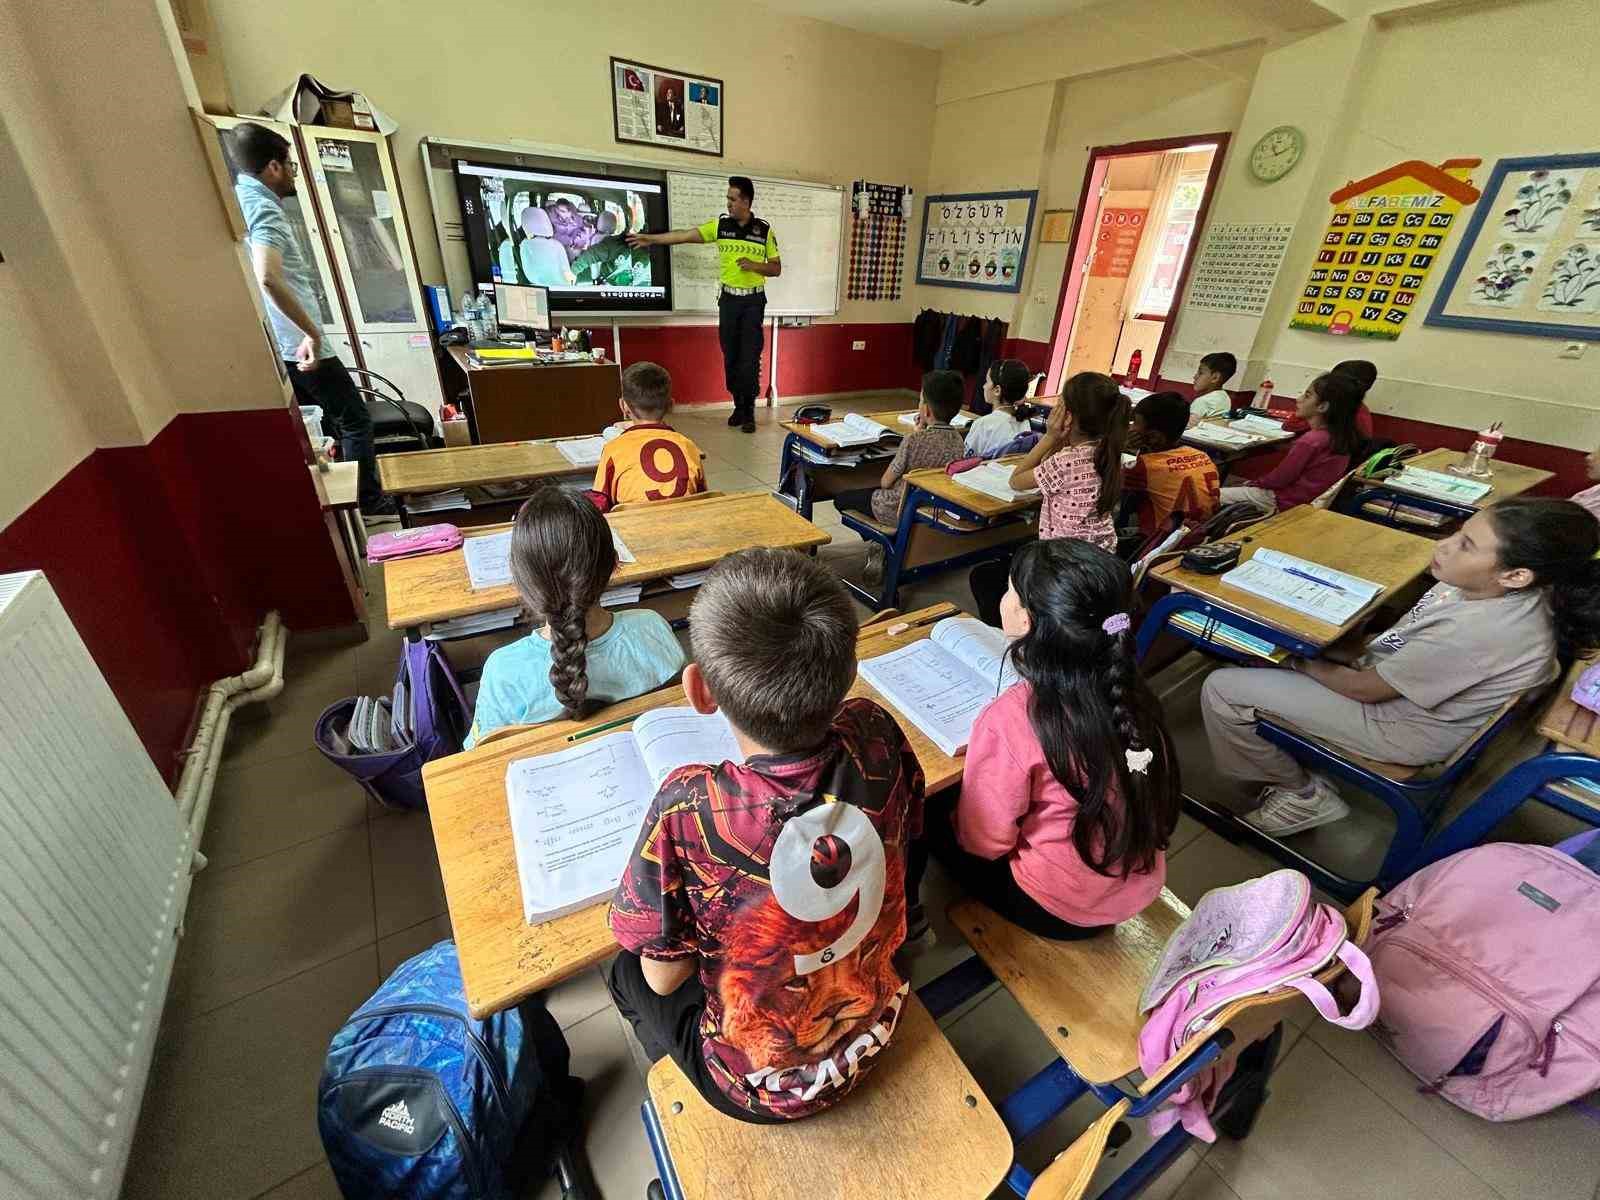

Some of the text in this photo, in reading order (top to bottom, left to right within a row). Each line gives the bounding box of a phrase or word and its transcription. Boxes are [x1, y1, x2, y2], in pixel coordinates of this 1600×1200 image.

[1333, 215, 1348, 224] Aa
[1355, 214, 1371, 223] Bb
[1380, 214, 1396, 224] Cc
[1431, 215, 1450, 225] Dd
[1327, 234, 1340, 242] Ee
[1348, 234, 1363, 243] Ff
[1371, 234, 1387, 245] Gg
[1421, 236, 1438, 246] Hh
[1363, 253, 1376, 264] Jj
[1387, 255, 1403, 264] Kk
[1312, 271, 1327, 280] Mm
[1332, 271, 1347, 280] Nn
[1355, 272, 1370, 281] Oo
[1403, 277, 1420, 287] Pp
[1306, 287, 1319, 295] Rr
[1325, 287, 1339, 296] Ss
[1373, 291, 1384, 300] Tt
[1396, 294, 1412, 304] Uu
[1320, 305, 1333, 313] Vv
[1366, 309, 1379, 319] Yy
[1387, 311, 1403, 321] Zz
[640, 439, 689, 500] 9
[769, 802, 886, 976] 9
[382, 1107, 415, 1126] NORTH
[378, 1117, 415, 1135] PACIFIC
